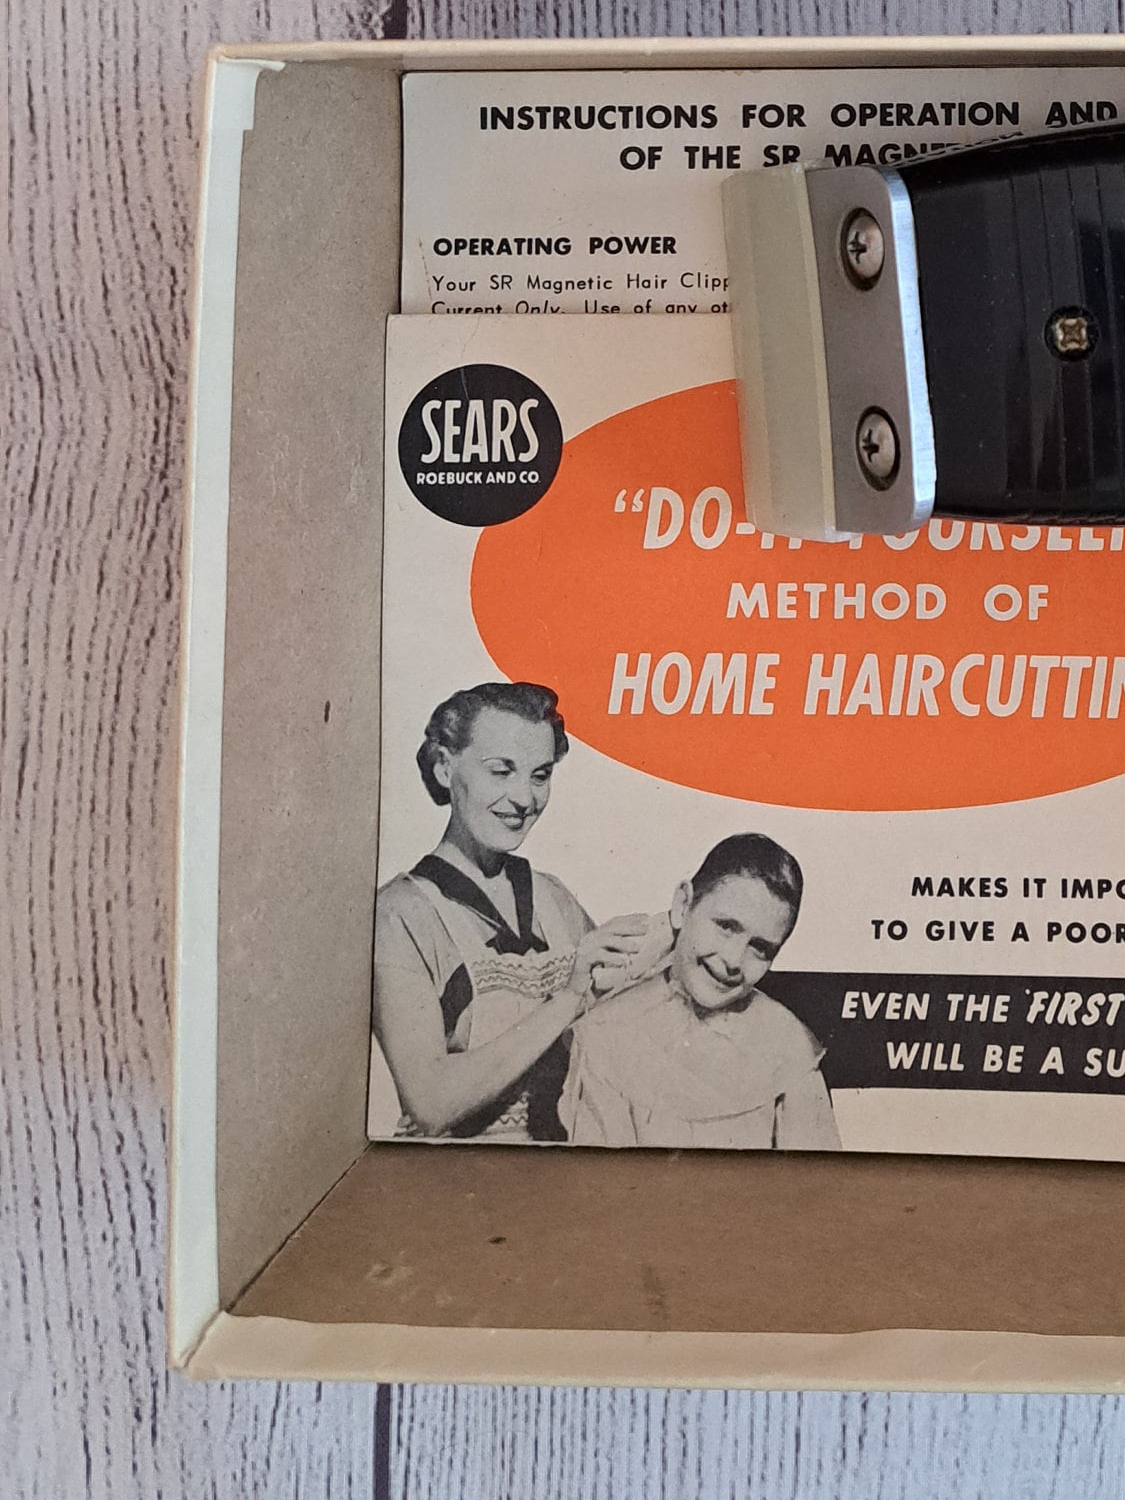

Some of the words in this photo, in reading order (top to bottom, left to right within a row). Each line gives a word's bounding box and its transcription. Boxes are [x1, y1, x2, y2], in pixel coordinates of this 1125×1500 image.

[479, 104, 718, 131] INSTRUCTIONS
[742, 103, 807, 129] FOR
[830, 101, 1020, 128] OPERATION
[1045, 100, 1118, 128] AND
[619, 145, 663, 171] OF
[683, 145, 741, 170] THE
[433, 237, 572, 257] OPERATING
[589, 236, 677, 255] POWER
[432, 275, 477, 292] Your
[489, 274, 513, 291] SR
[526, 274, 613, 295] Magnetic
[626, 273, 668, 290] Hair
[584, 300, 621, 314] Use
[633, 299, 652, 314] of
[420, 398, 539, 464] SEARS
[416, 471, 483, 485] ROEBUCK
[485, 471, 517, 484] AND
[725, 582, 947, 620] METHOD
[983, 583, 1049, 622] OF
[607, 651, 777, 716] HOME
[911, 876, 1009, 898] MAKES
[1023, 877, 1047, 899] IT
[870, 919, 908, 941] TO
[925, 920, 995, 942] GIVE
[1010, 921, 1030, 942] A
[841, 991, 930, 1021] EVEN
[946, 993, 1011, 1023] THE
[1025, 989, 1125, 1027] FIRST
[886, 1041, 965, 1071] WILL
[982, 1044, 1025, 1073] BE
[1039, 1046, 1065, 1075] A
